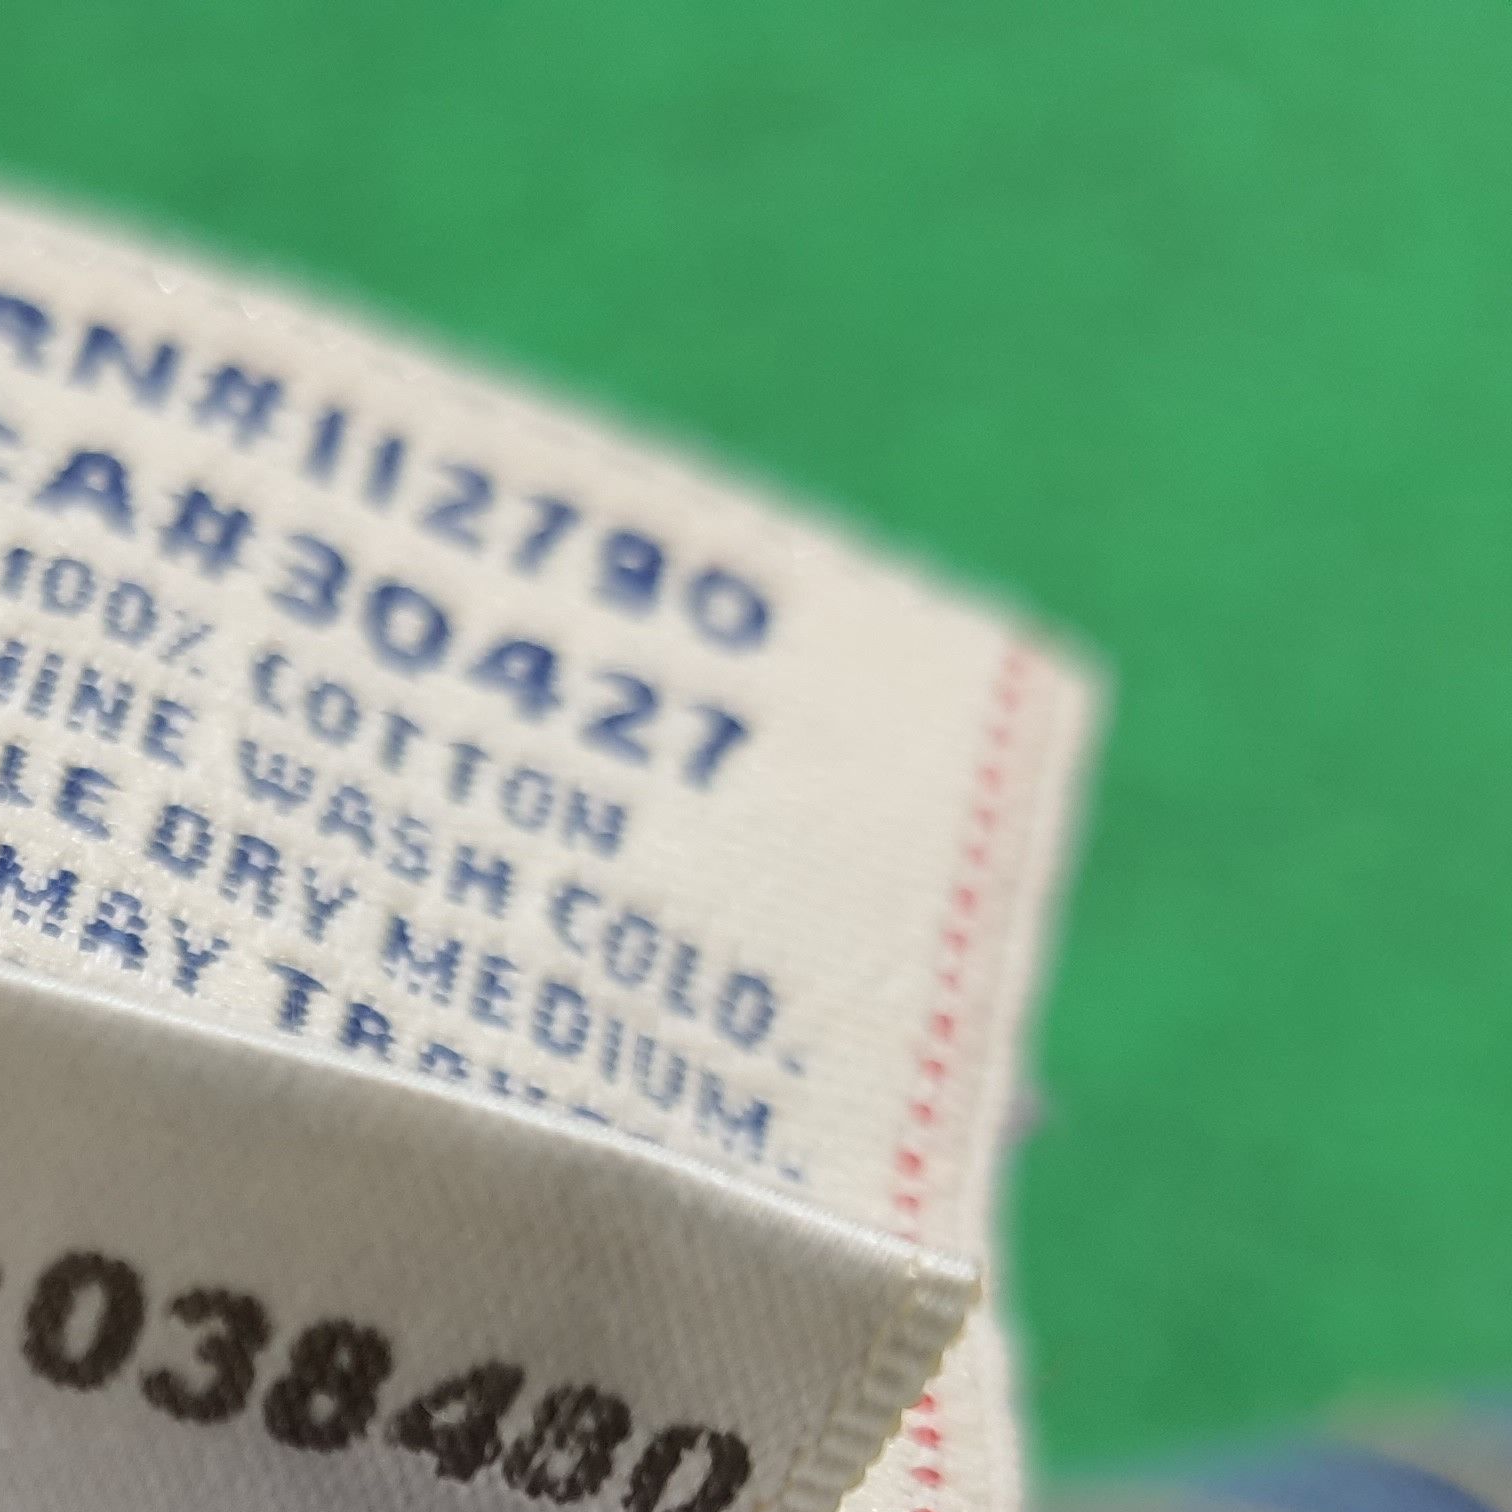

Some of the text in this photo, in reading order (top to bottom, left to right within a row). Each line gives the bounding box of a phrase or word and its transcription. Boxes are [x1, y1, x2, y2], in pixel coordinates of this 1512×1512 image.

[0, 547, 627, 858] 100% COTTON
[146, 803, 357, 943] DRY
[383, 915, 803, 1181] MEDIUM.
[237, 739, 512, 919] WASH
[550, 884, 804, 1076] COLD.
